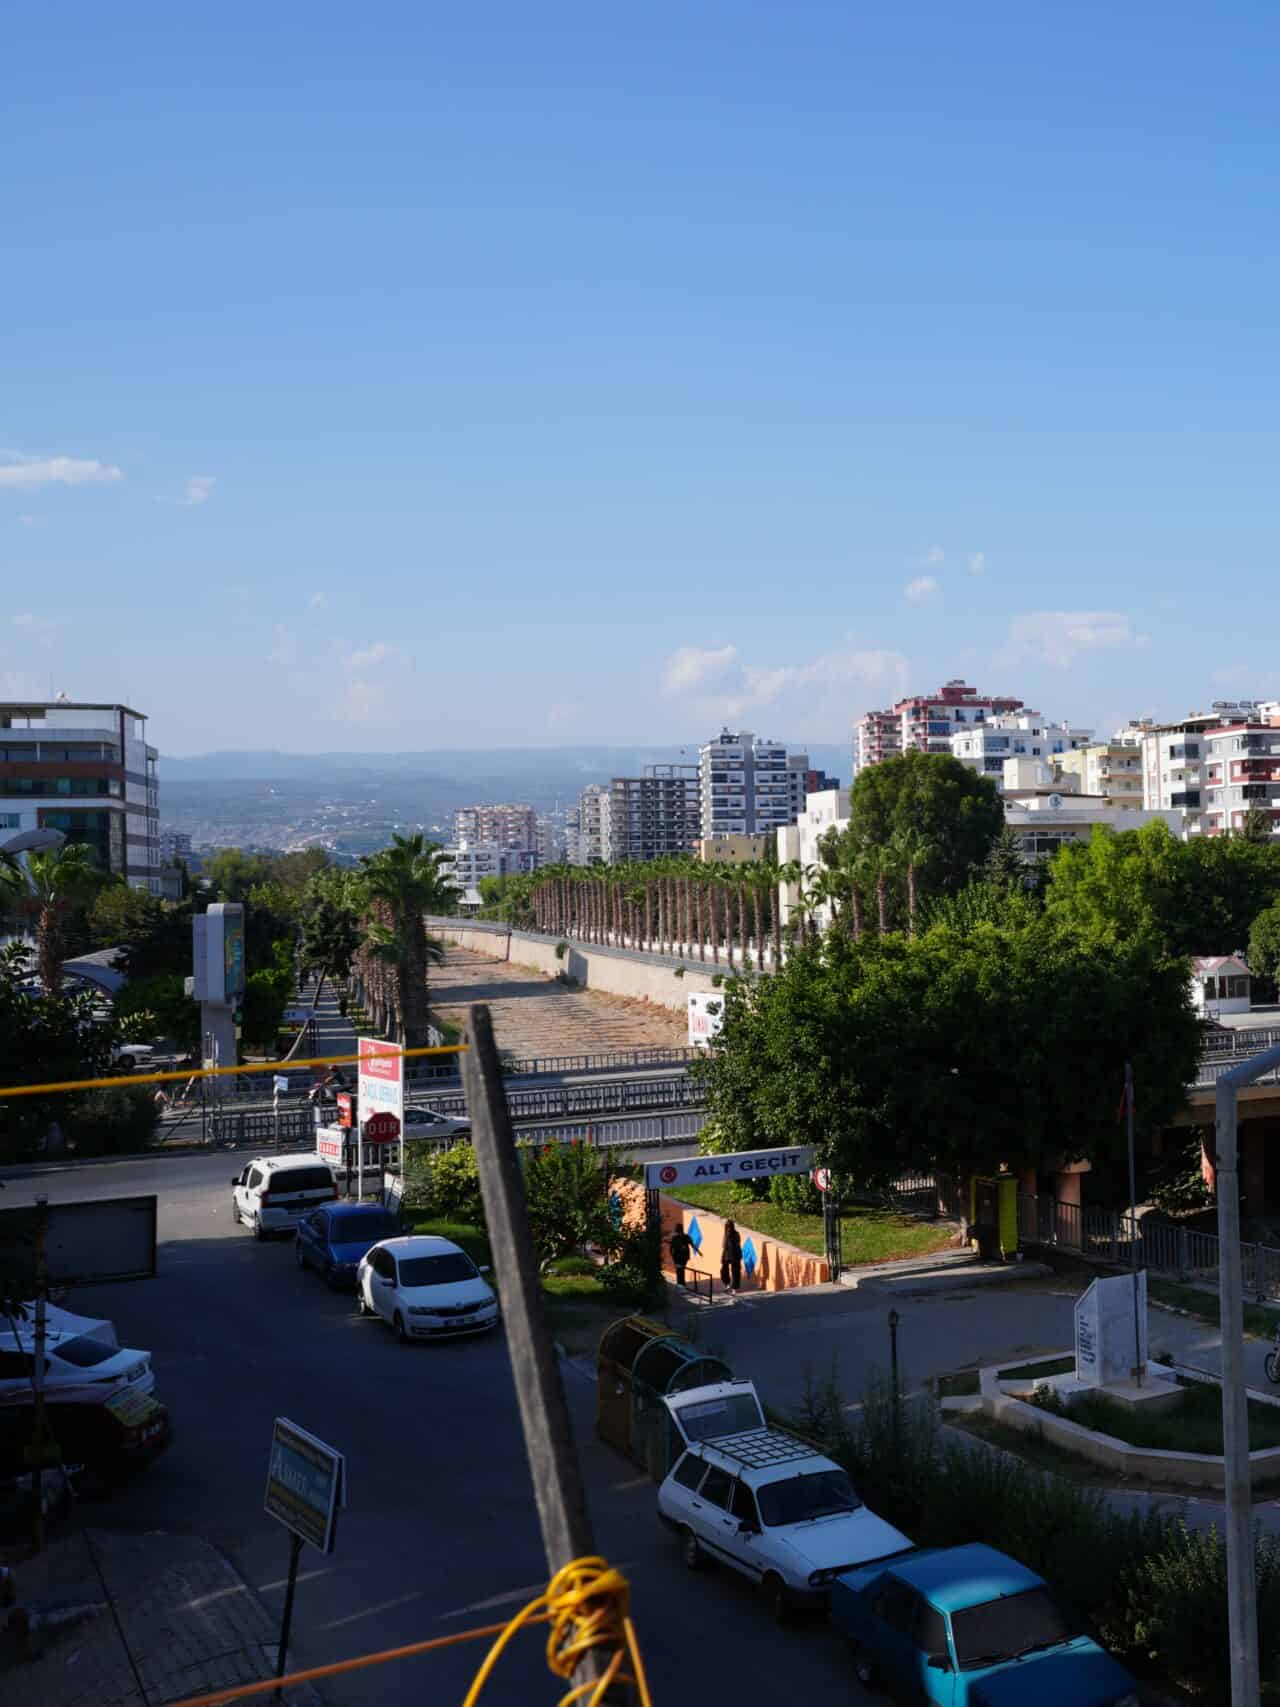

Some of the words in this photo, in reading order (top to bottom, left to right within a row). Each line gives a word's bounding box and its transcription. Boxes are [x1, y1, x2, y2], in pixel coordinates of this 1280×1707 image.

[368, 1121, 398, 1136] DUR
[694, 1162, 732, 1177] ALT
[739, 1153, 801, 1172] GEÇİT
